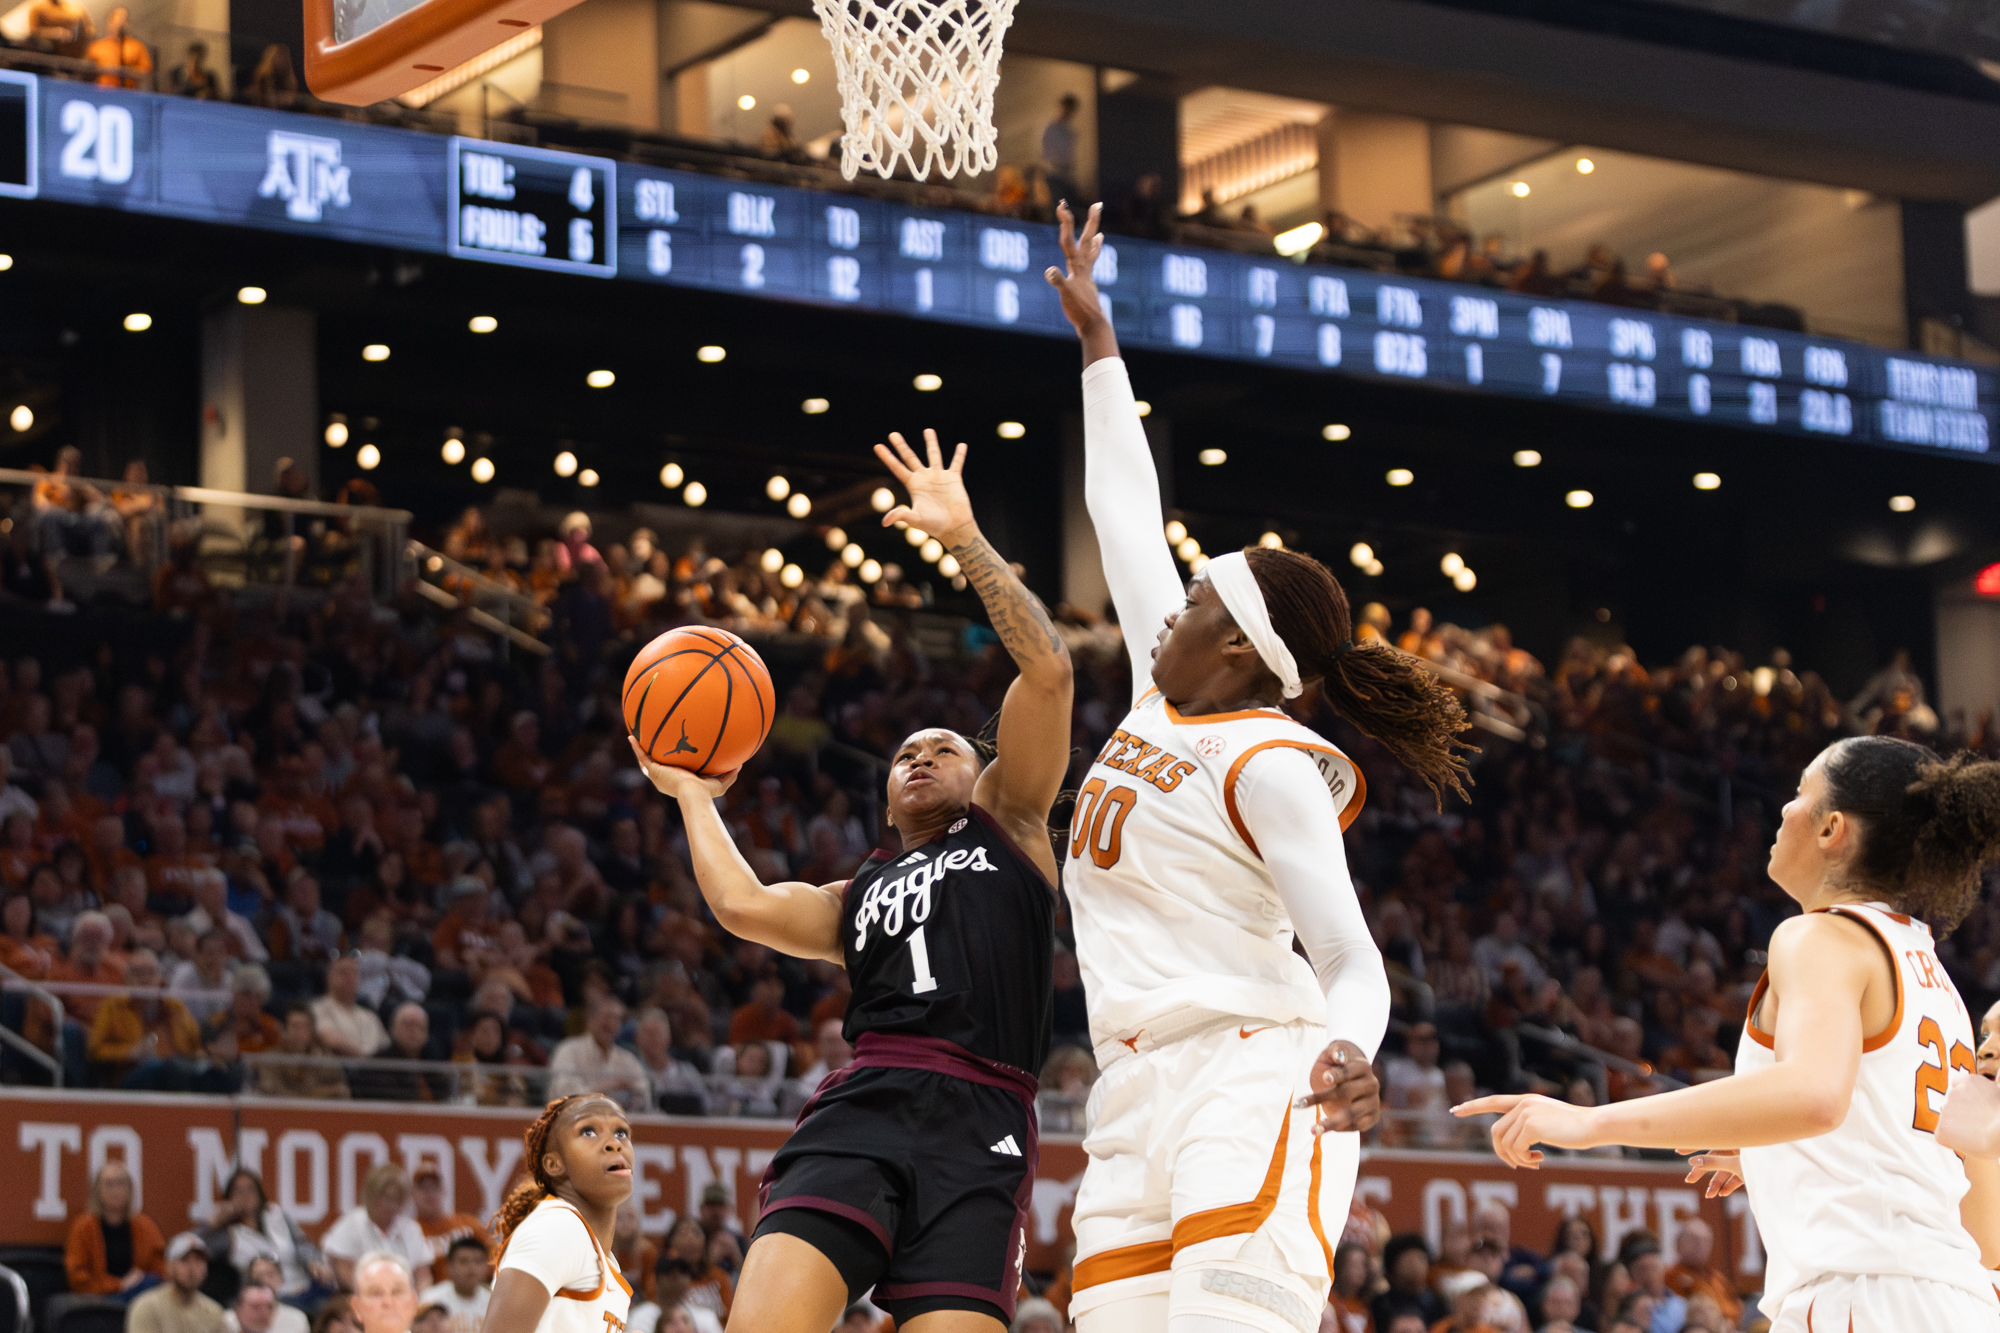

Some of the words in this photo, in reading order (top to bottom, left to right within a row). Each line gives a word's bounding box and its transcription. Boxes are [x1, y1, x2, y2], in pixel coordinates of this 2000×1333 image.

[61, 101, 133, 184] 20
[461, 204, 547, 256] FOULS:
[568, 167, 595, 212] 4
[634, 178, 679, 224] STL
[728, 192, 776, 238] BLK
[826, 205, 860, 250] TO
[901, 217, 946, 262] AST
[740, 243, 765, 288] 2
[828, 256, 861, 300] 12
[915, 267, 933, 312] 1
[995, 278, 1020, 324] 6
[1253, 314, 1275, 357] 7
[1465, 342, 1484, 384] 1
[1540, 353, 1562, 395] 7
[1096, 729, 1197, 793] TEXAS
[1071, 777, 1137, 870] 00
[855, 846, 998, 952] Aggies
[905, 925, 938, 995] 1
[19, 1121, 143, 1221] TO
[187, 1126, 526, 1228] MOODY
